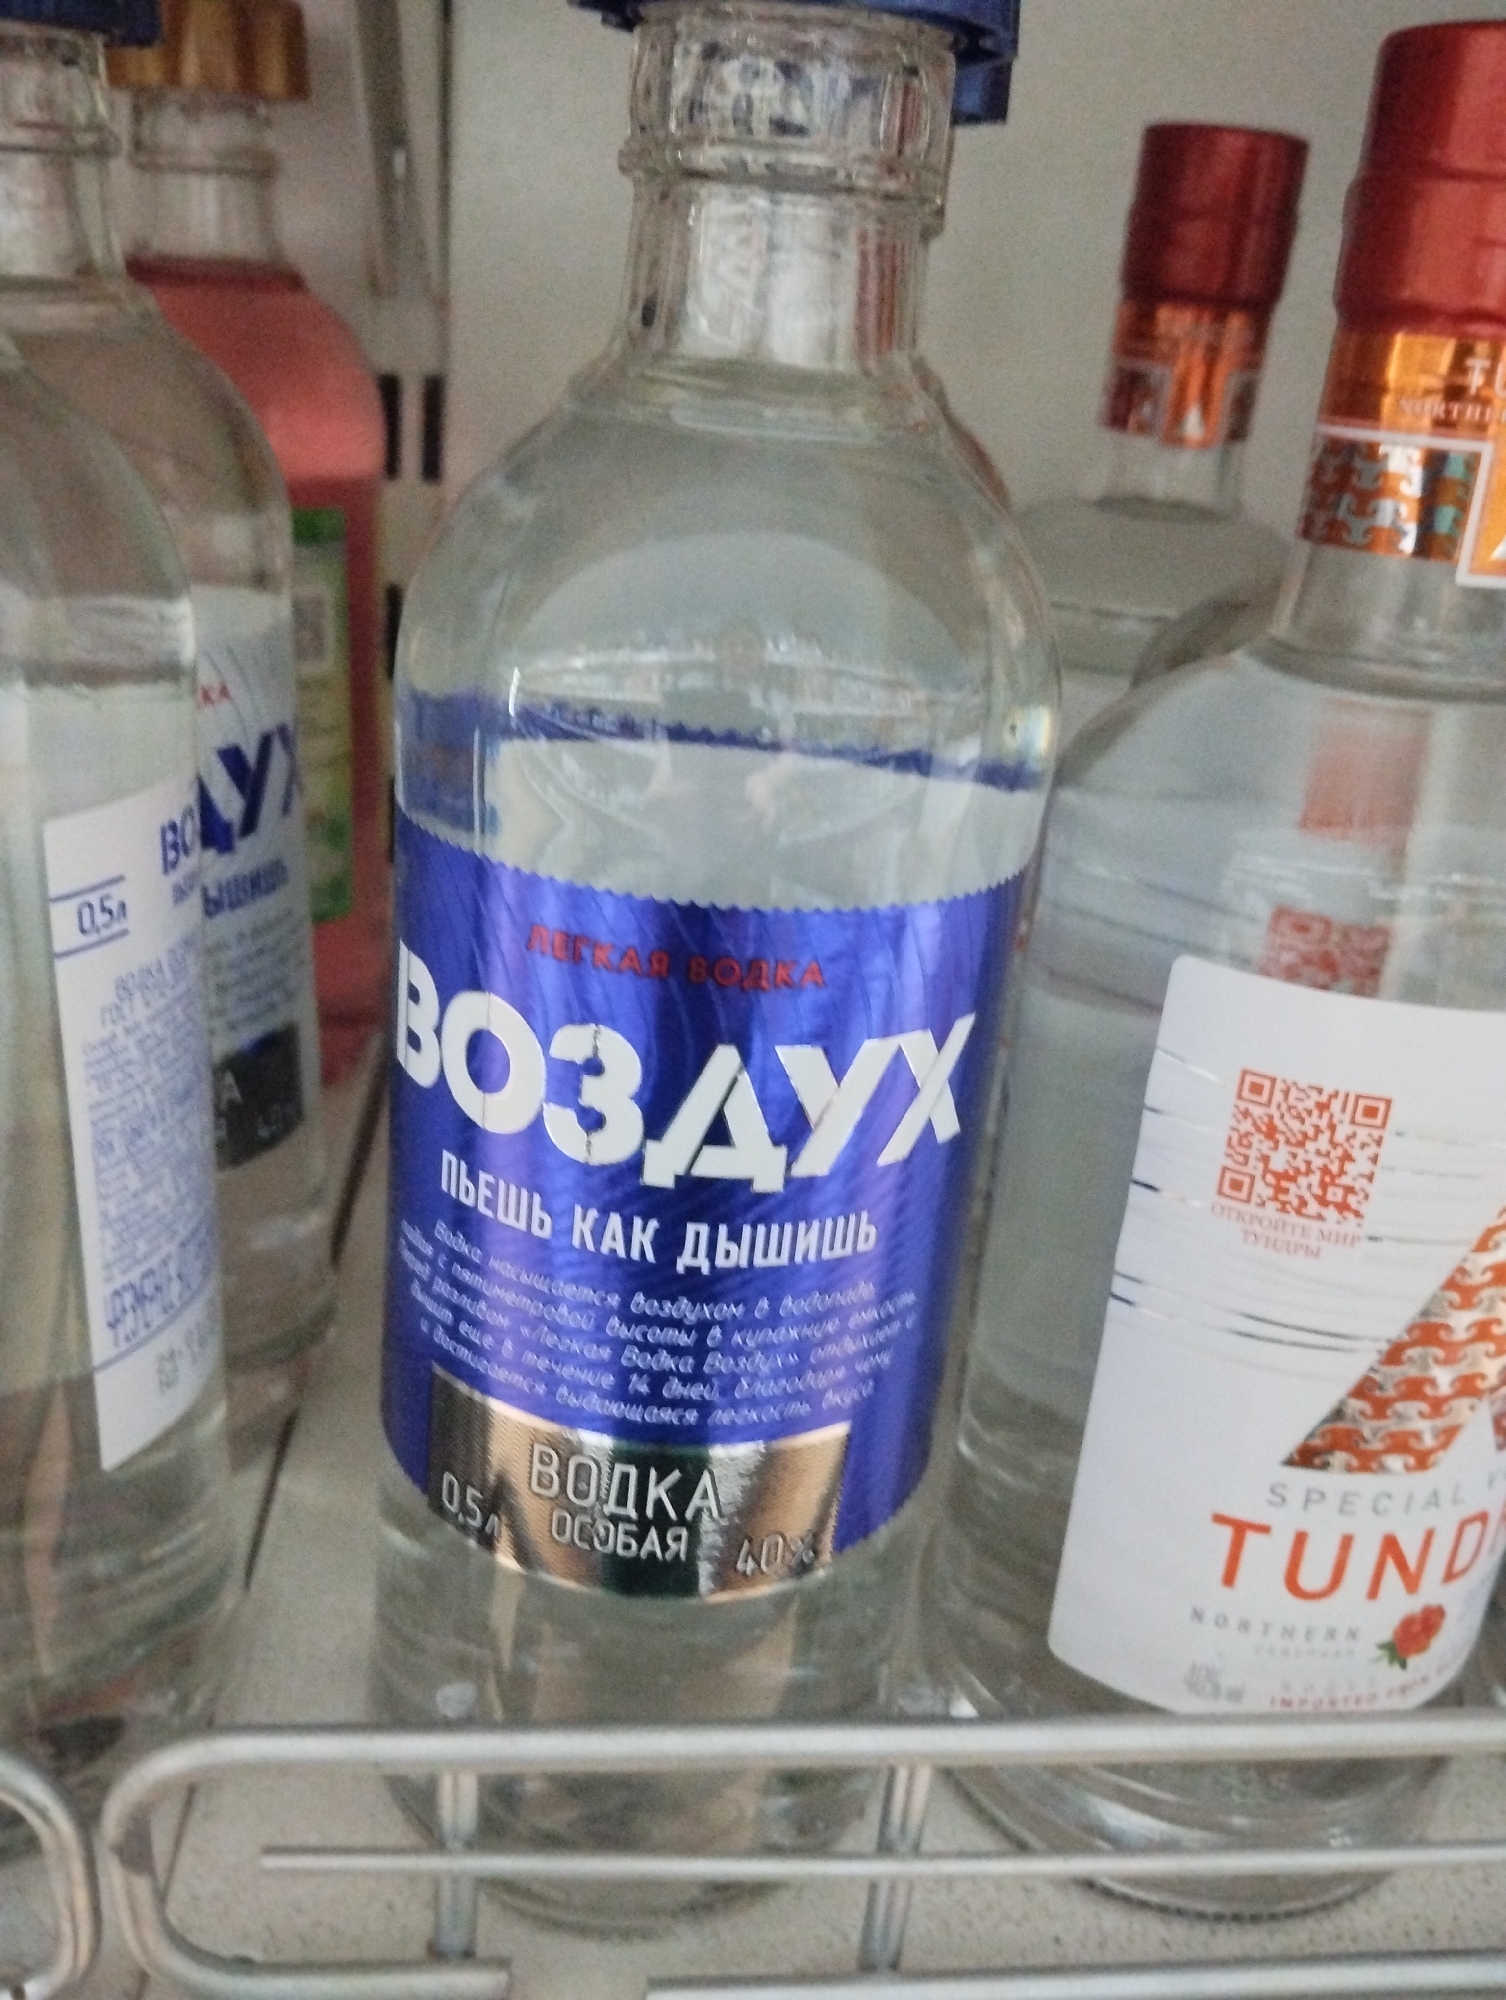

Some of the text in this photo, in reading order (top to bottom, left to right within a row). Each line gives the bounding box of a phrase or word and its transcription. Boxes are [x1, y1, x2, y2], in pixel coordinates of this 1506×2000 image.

[526, 924, 826, 993] ЛЕГКАЯ ВОДКА
[397, 938, 976, 1194] ВОЗДУХ
[440, 1149, 878, 1275] ПЬЕШЬ КАК ДЫШИШЬ
[630, 1291, 746, 1325] воздухом
[755, 1296, 770, 1319] в
[606, 1314, 698, 1346] высоты
[707, 1324, 722, 1347] в
[620, 1344, 696, 1373] Водка
[555, 1383, 699, 1425] выдающаяся
[529, 1443, 726, 1522] ВОДКА
[1267, 1482, 1467, 1517] SPECIAL
[550, 1508, 689, 1562] ОСОБАЯ
[736, 1530, 816, 1577] 40%
[1189, 1605, 1360, 1643] NORTHERN
